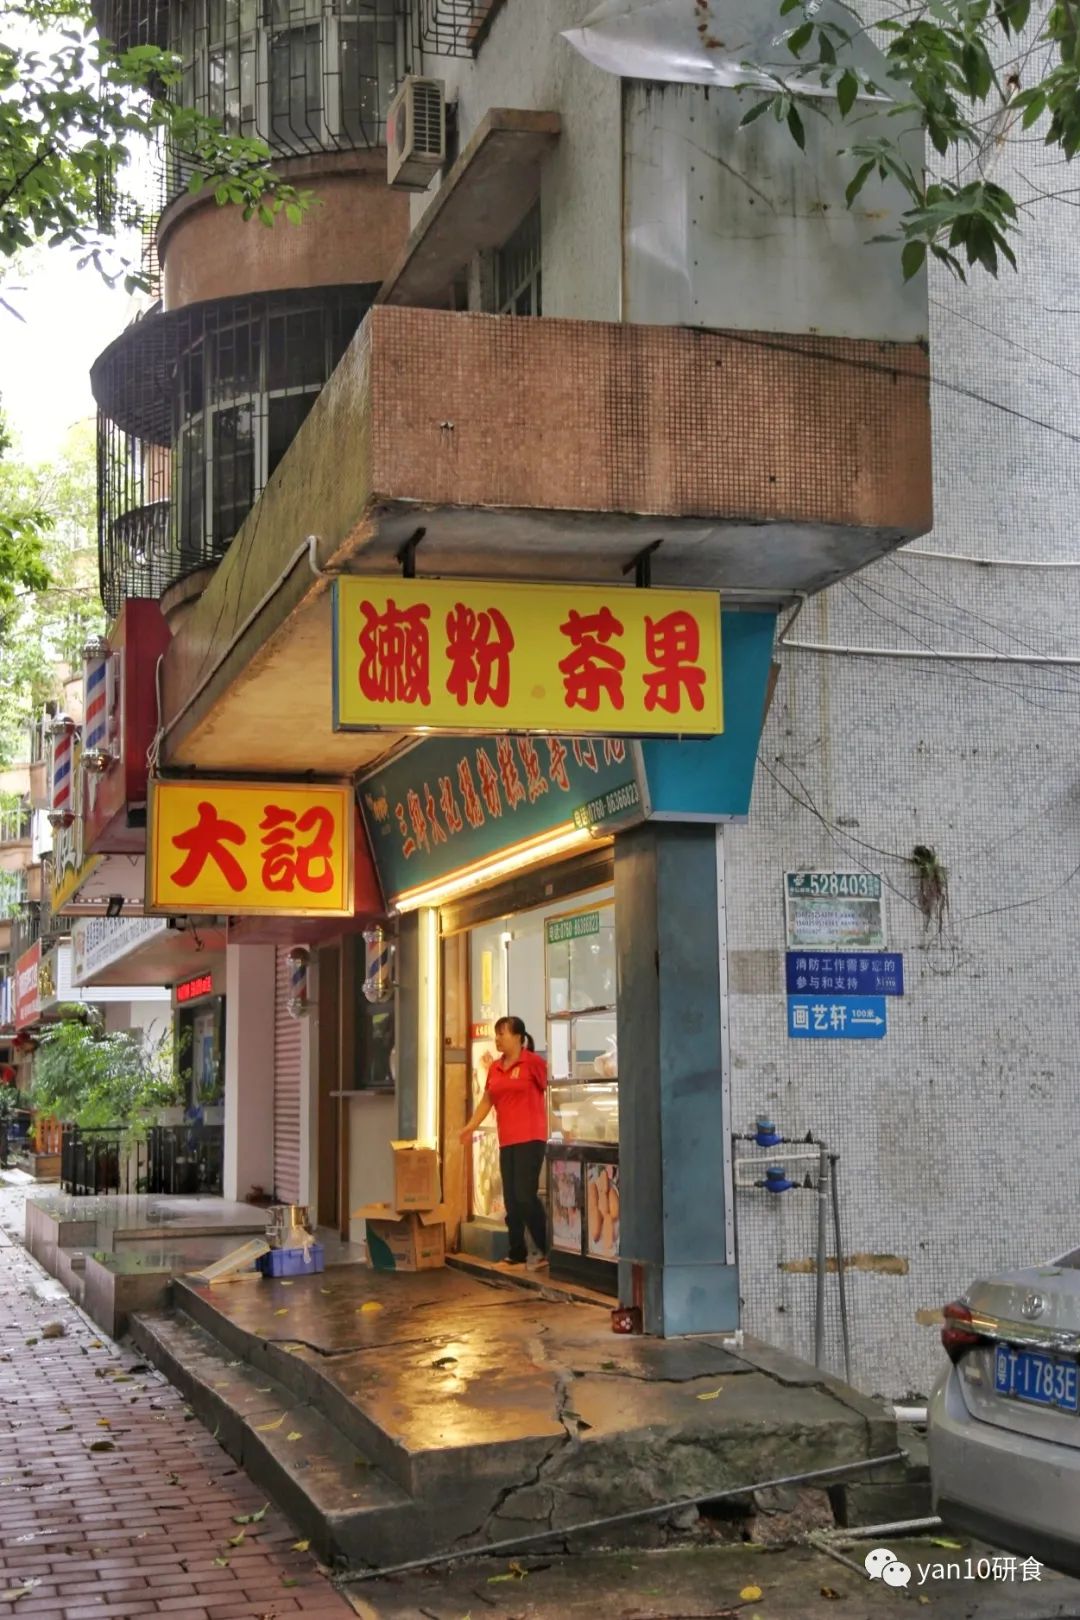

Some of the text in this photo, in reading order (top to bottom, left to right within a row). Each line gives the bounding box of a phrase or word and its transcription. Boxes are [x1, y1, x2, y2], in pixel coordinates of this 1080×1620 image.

[558, 606, 706, 714] 茶果
[810, 874, 868, 896] 528403
[796, 957, 895, 973] 消防工作需要您的
[796, 976, 858, 990] 参与和支持
[793, 1004, 874, 1031] 画艺轩 100米
